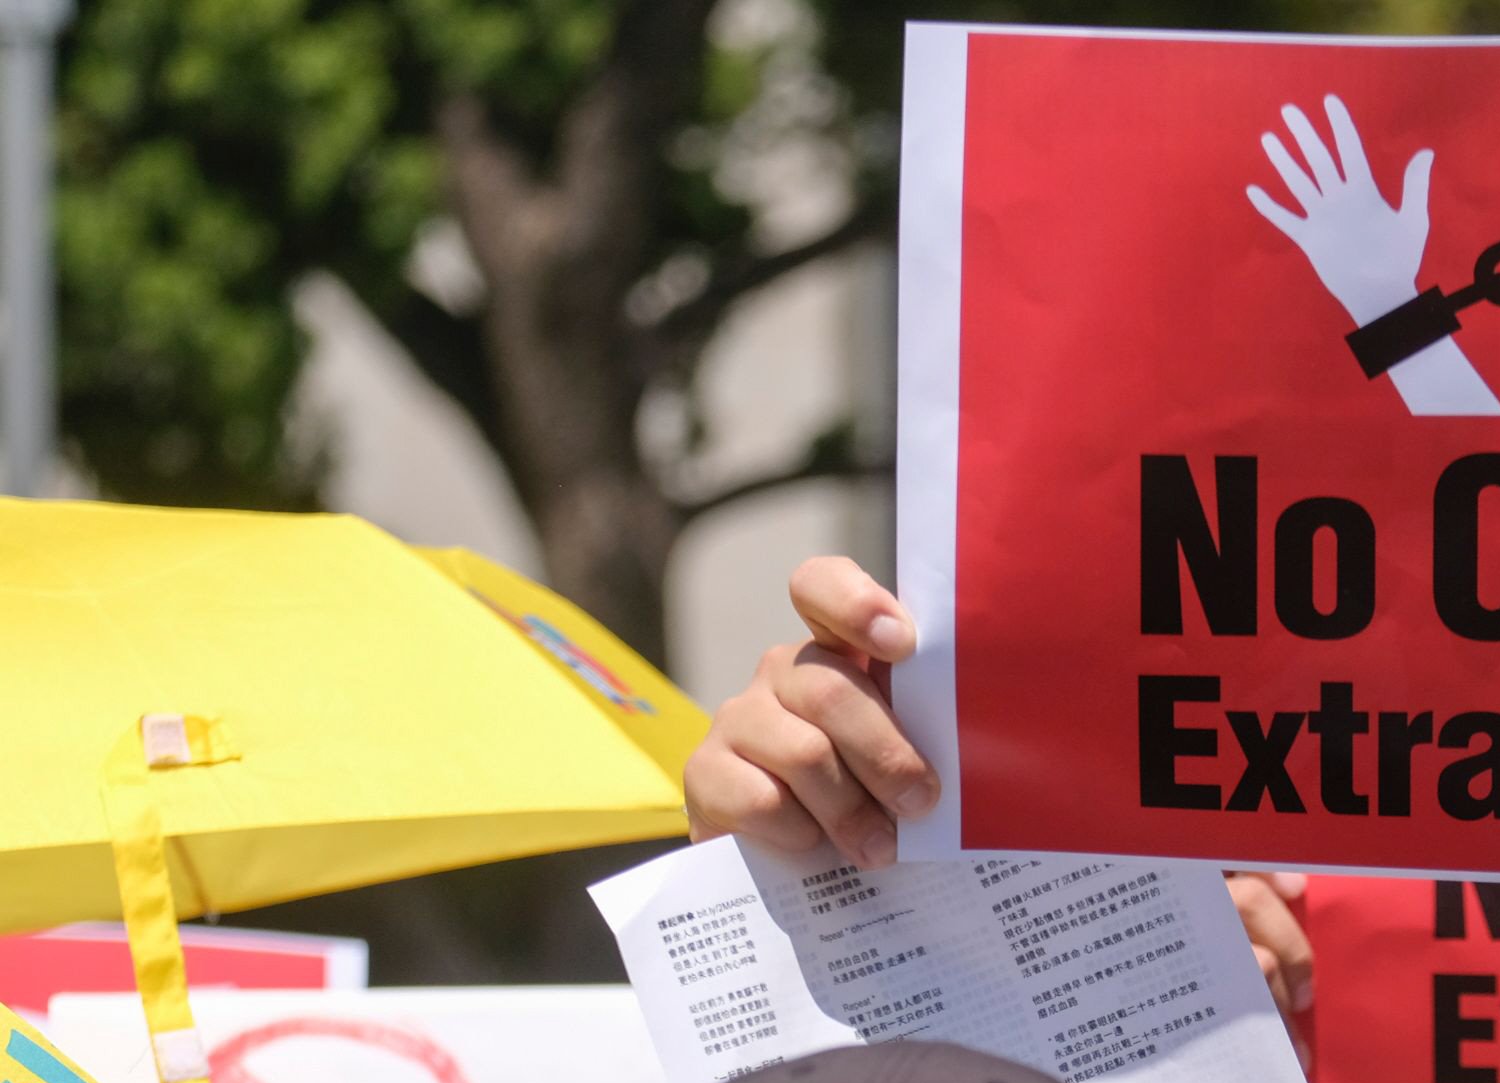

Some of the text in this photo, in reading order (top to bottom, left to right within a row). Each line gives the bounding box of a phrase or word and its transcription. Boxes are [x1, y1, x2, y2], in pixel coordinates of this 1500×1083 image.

[1140, 453, 1376, 642] No
[842, 997, 871, 1012] Repeat
[1204, 1006, 1216, 1017] 我
